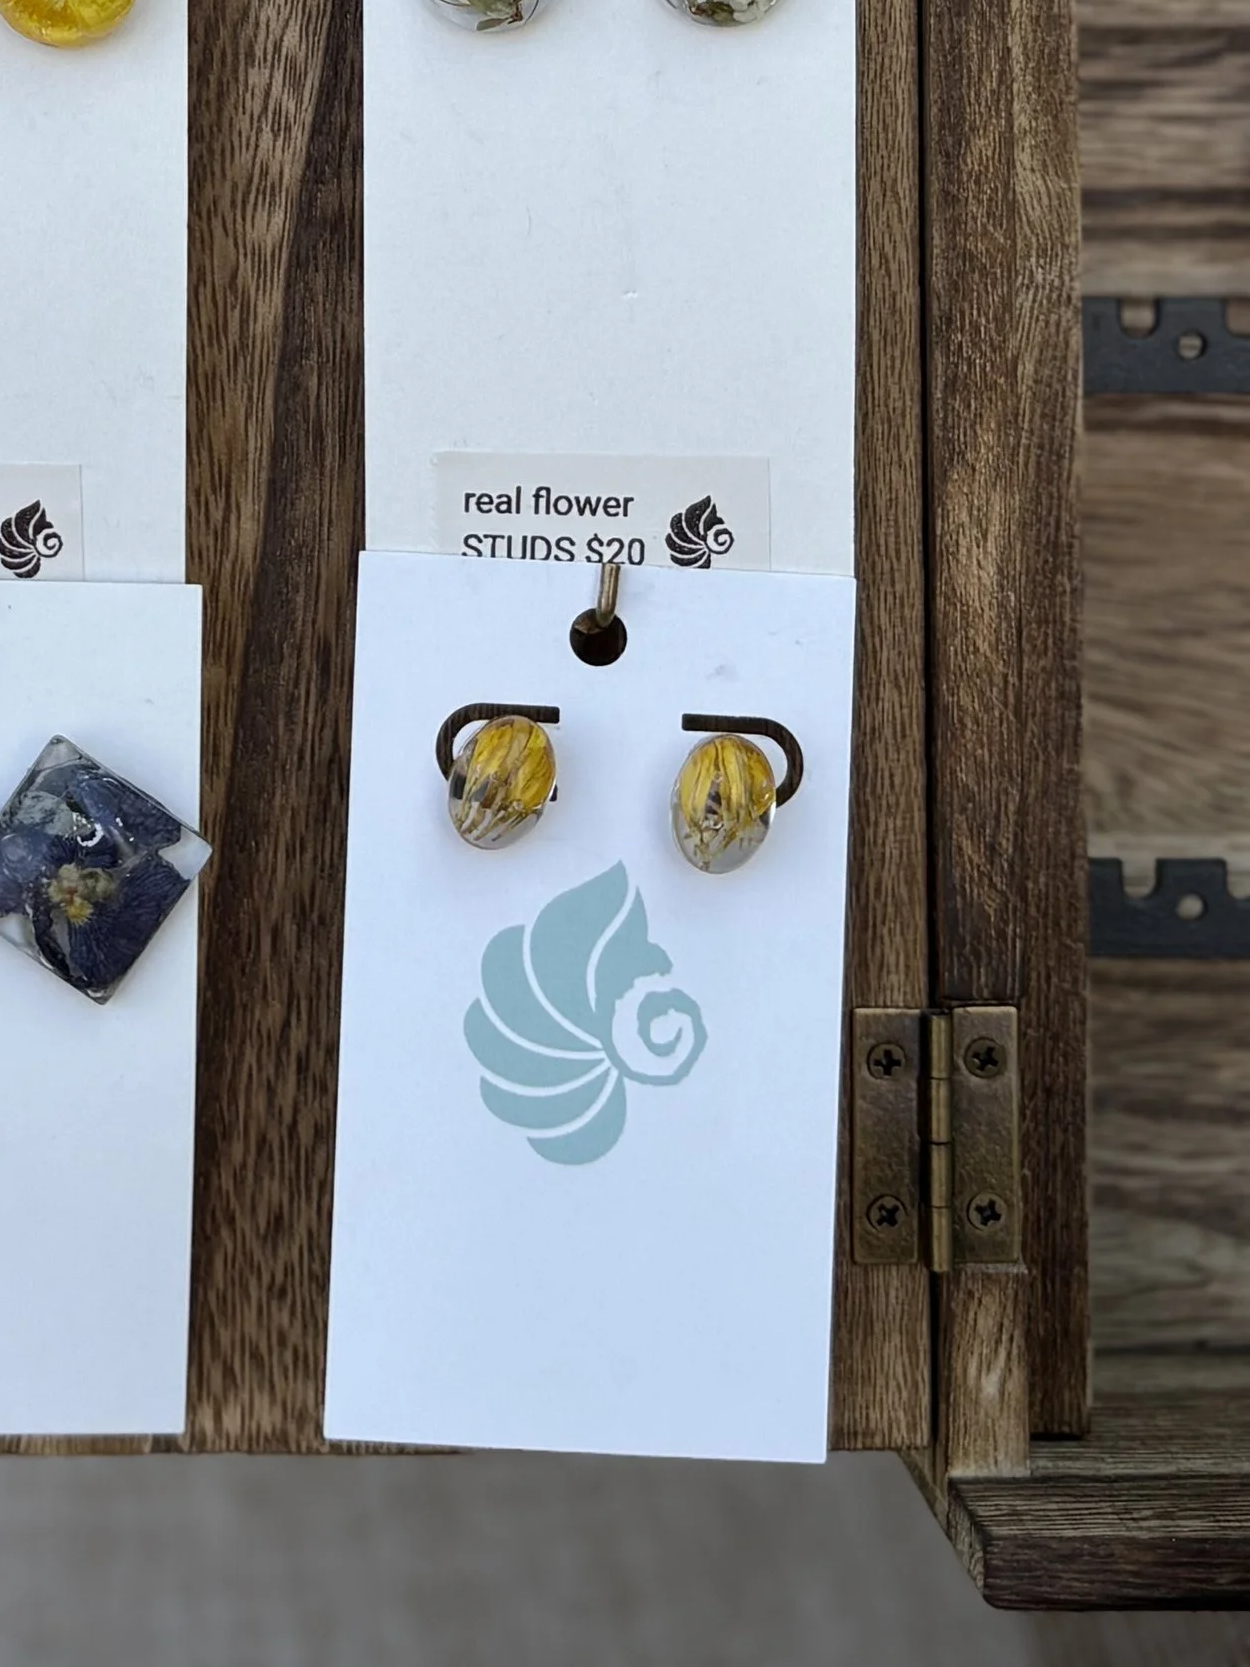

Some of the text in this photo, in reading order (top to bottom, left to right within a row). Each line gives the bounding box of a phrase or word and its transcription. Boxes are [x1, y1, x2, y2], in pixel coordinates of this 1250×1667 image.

[464, 485, 635, 518] real flower
[461, 533, 646, 566] STUDS $20
